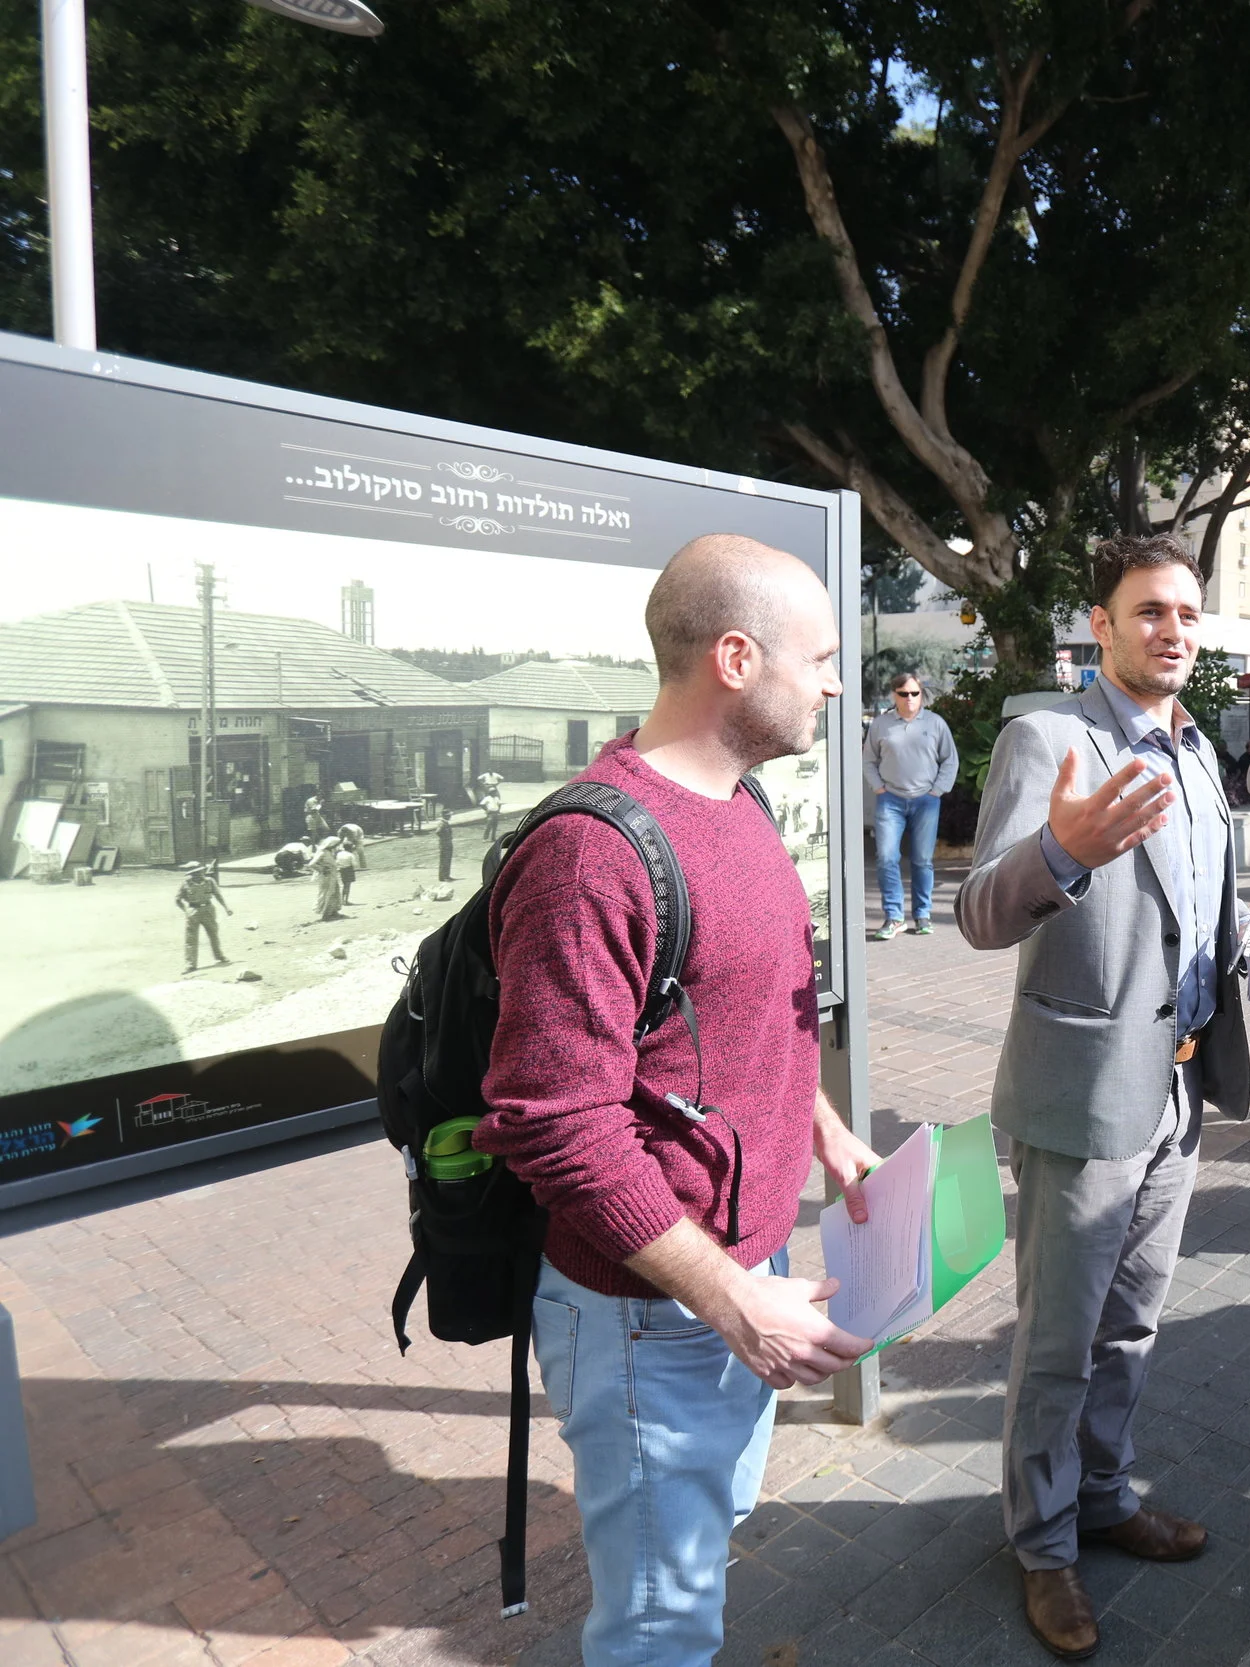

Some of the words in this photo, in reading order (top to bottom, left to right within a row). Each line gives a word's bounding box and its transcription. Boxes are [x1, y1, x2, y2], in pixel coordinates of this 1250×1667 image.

[285, 464, 422, 501] סוקולוב...
[430, 483, 488, 510] רחוב
[496, 493, 574, 522] תולדות
[581, 502, 630, 529] ואלה
